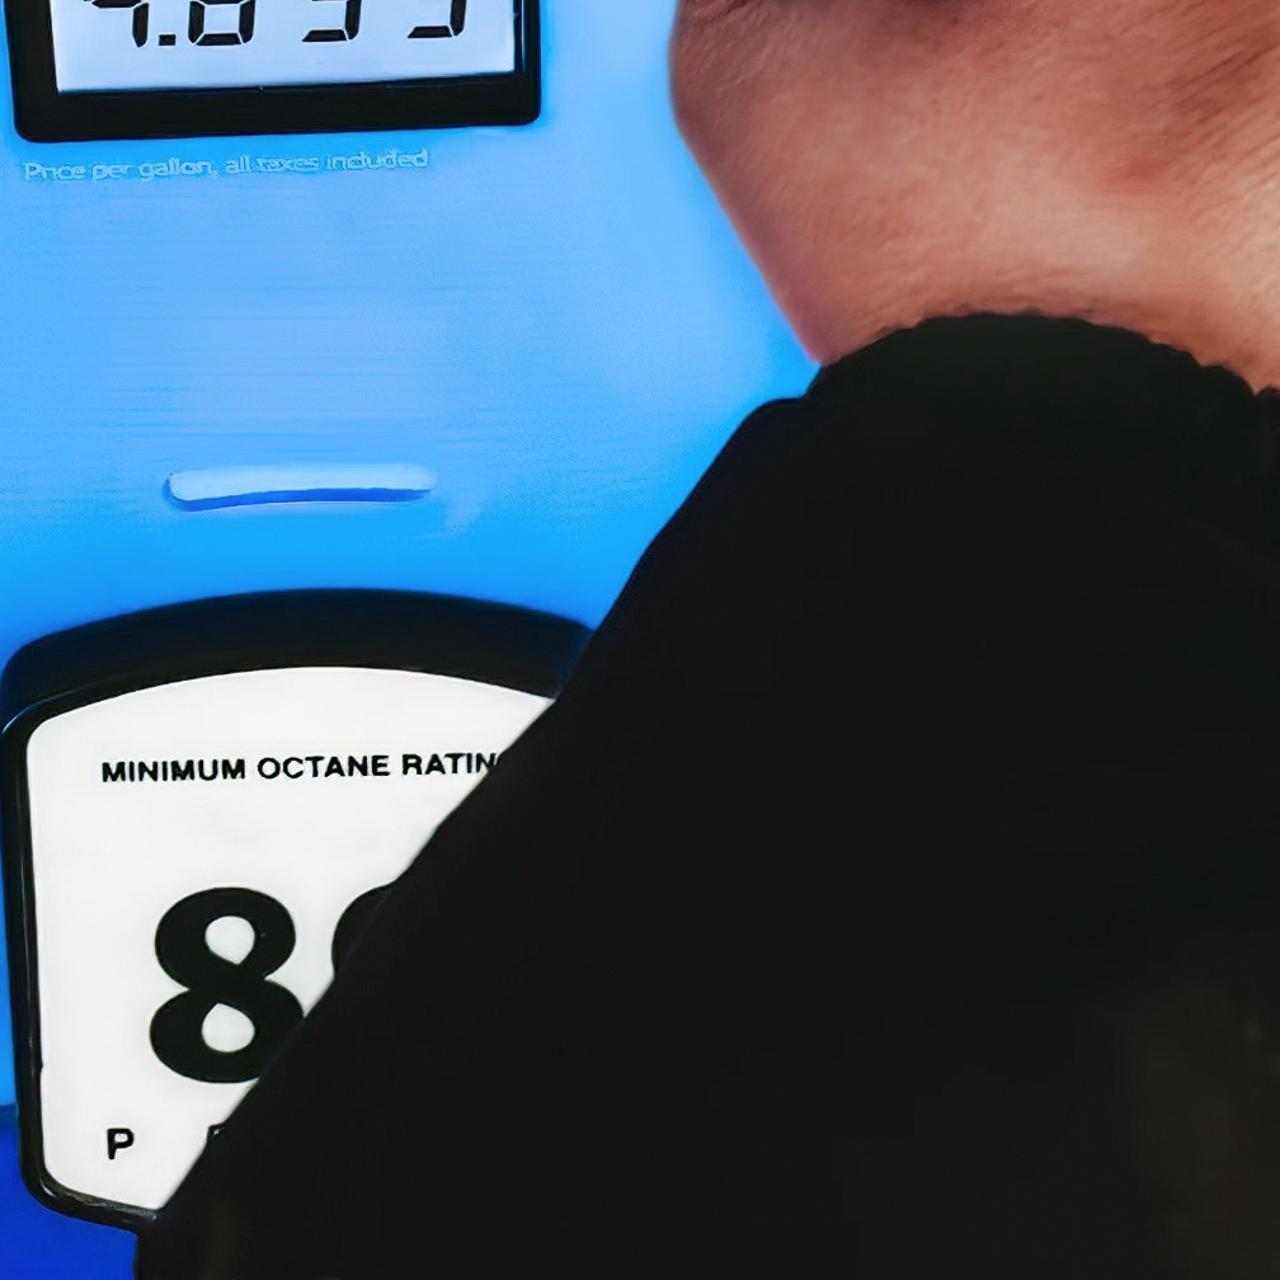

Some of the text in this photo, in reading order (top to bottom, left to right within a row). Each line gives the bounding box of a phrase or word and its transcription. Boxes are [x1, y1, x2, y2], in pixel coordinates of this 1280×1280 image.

[91, 162, 131, 183] per
[139, 156, 219, 183] gallon,
[225, 153, 251, 174] all
[325, 148, 429, 170] included
[102, 752, 502, 783] MINIMUM OCTANE RATIN
[149, 886, 398, 1084] 8
